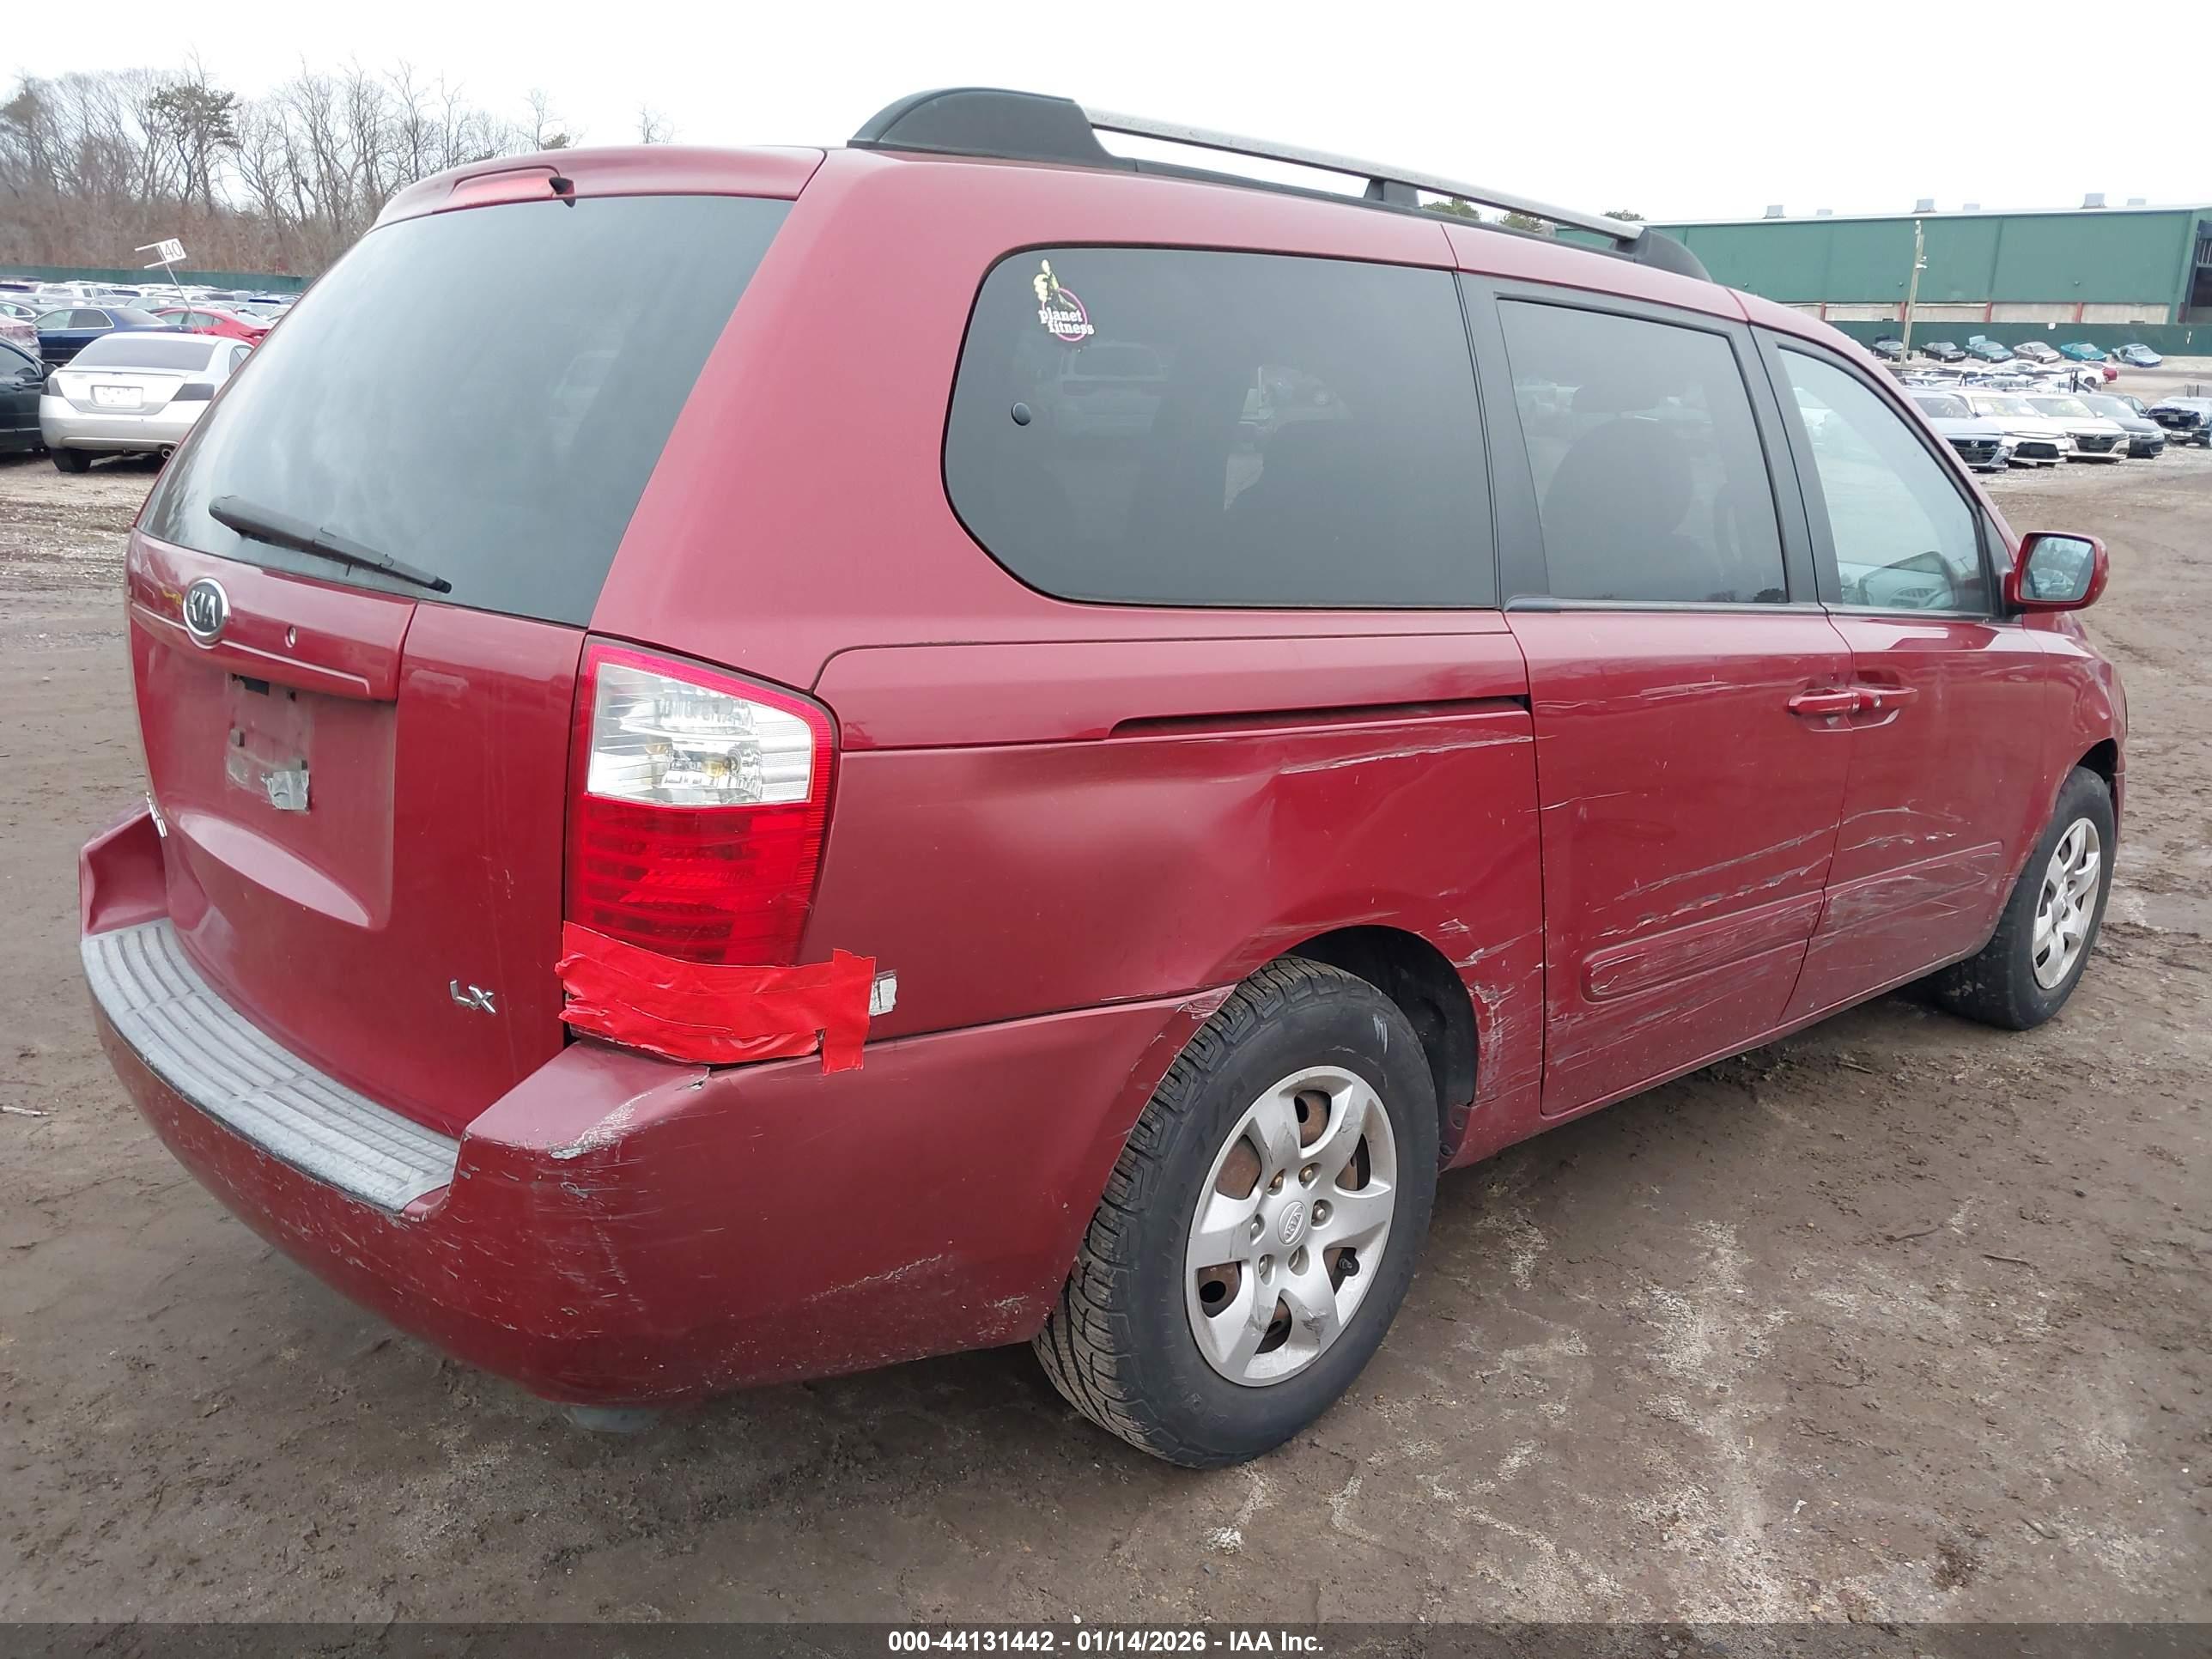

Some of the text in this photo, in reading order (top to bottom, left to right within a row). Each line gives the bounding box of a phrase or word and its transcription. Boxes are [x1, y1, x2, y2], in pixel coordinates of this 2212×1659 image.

[1037, 307, 1084, 325] planet
[1048, 320, 1095, 335] fitness
[189, 590, 217, 627] KIA
[449, 979, 496, 1016] LX
